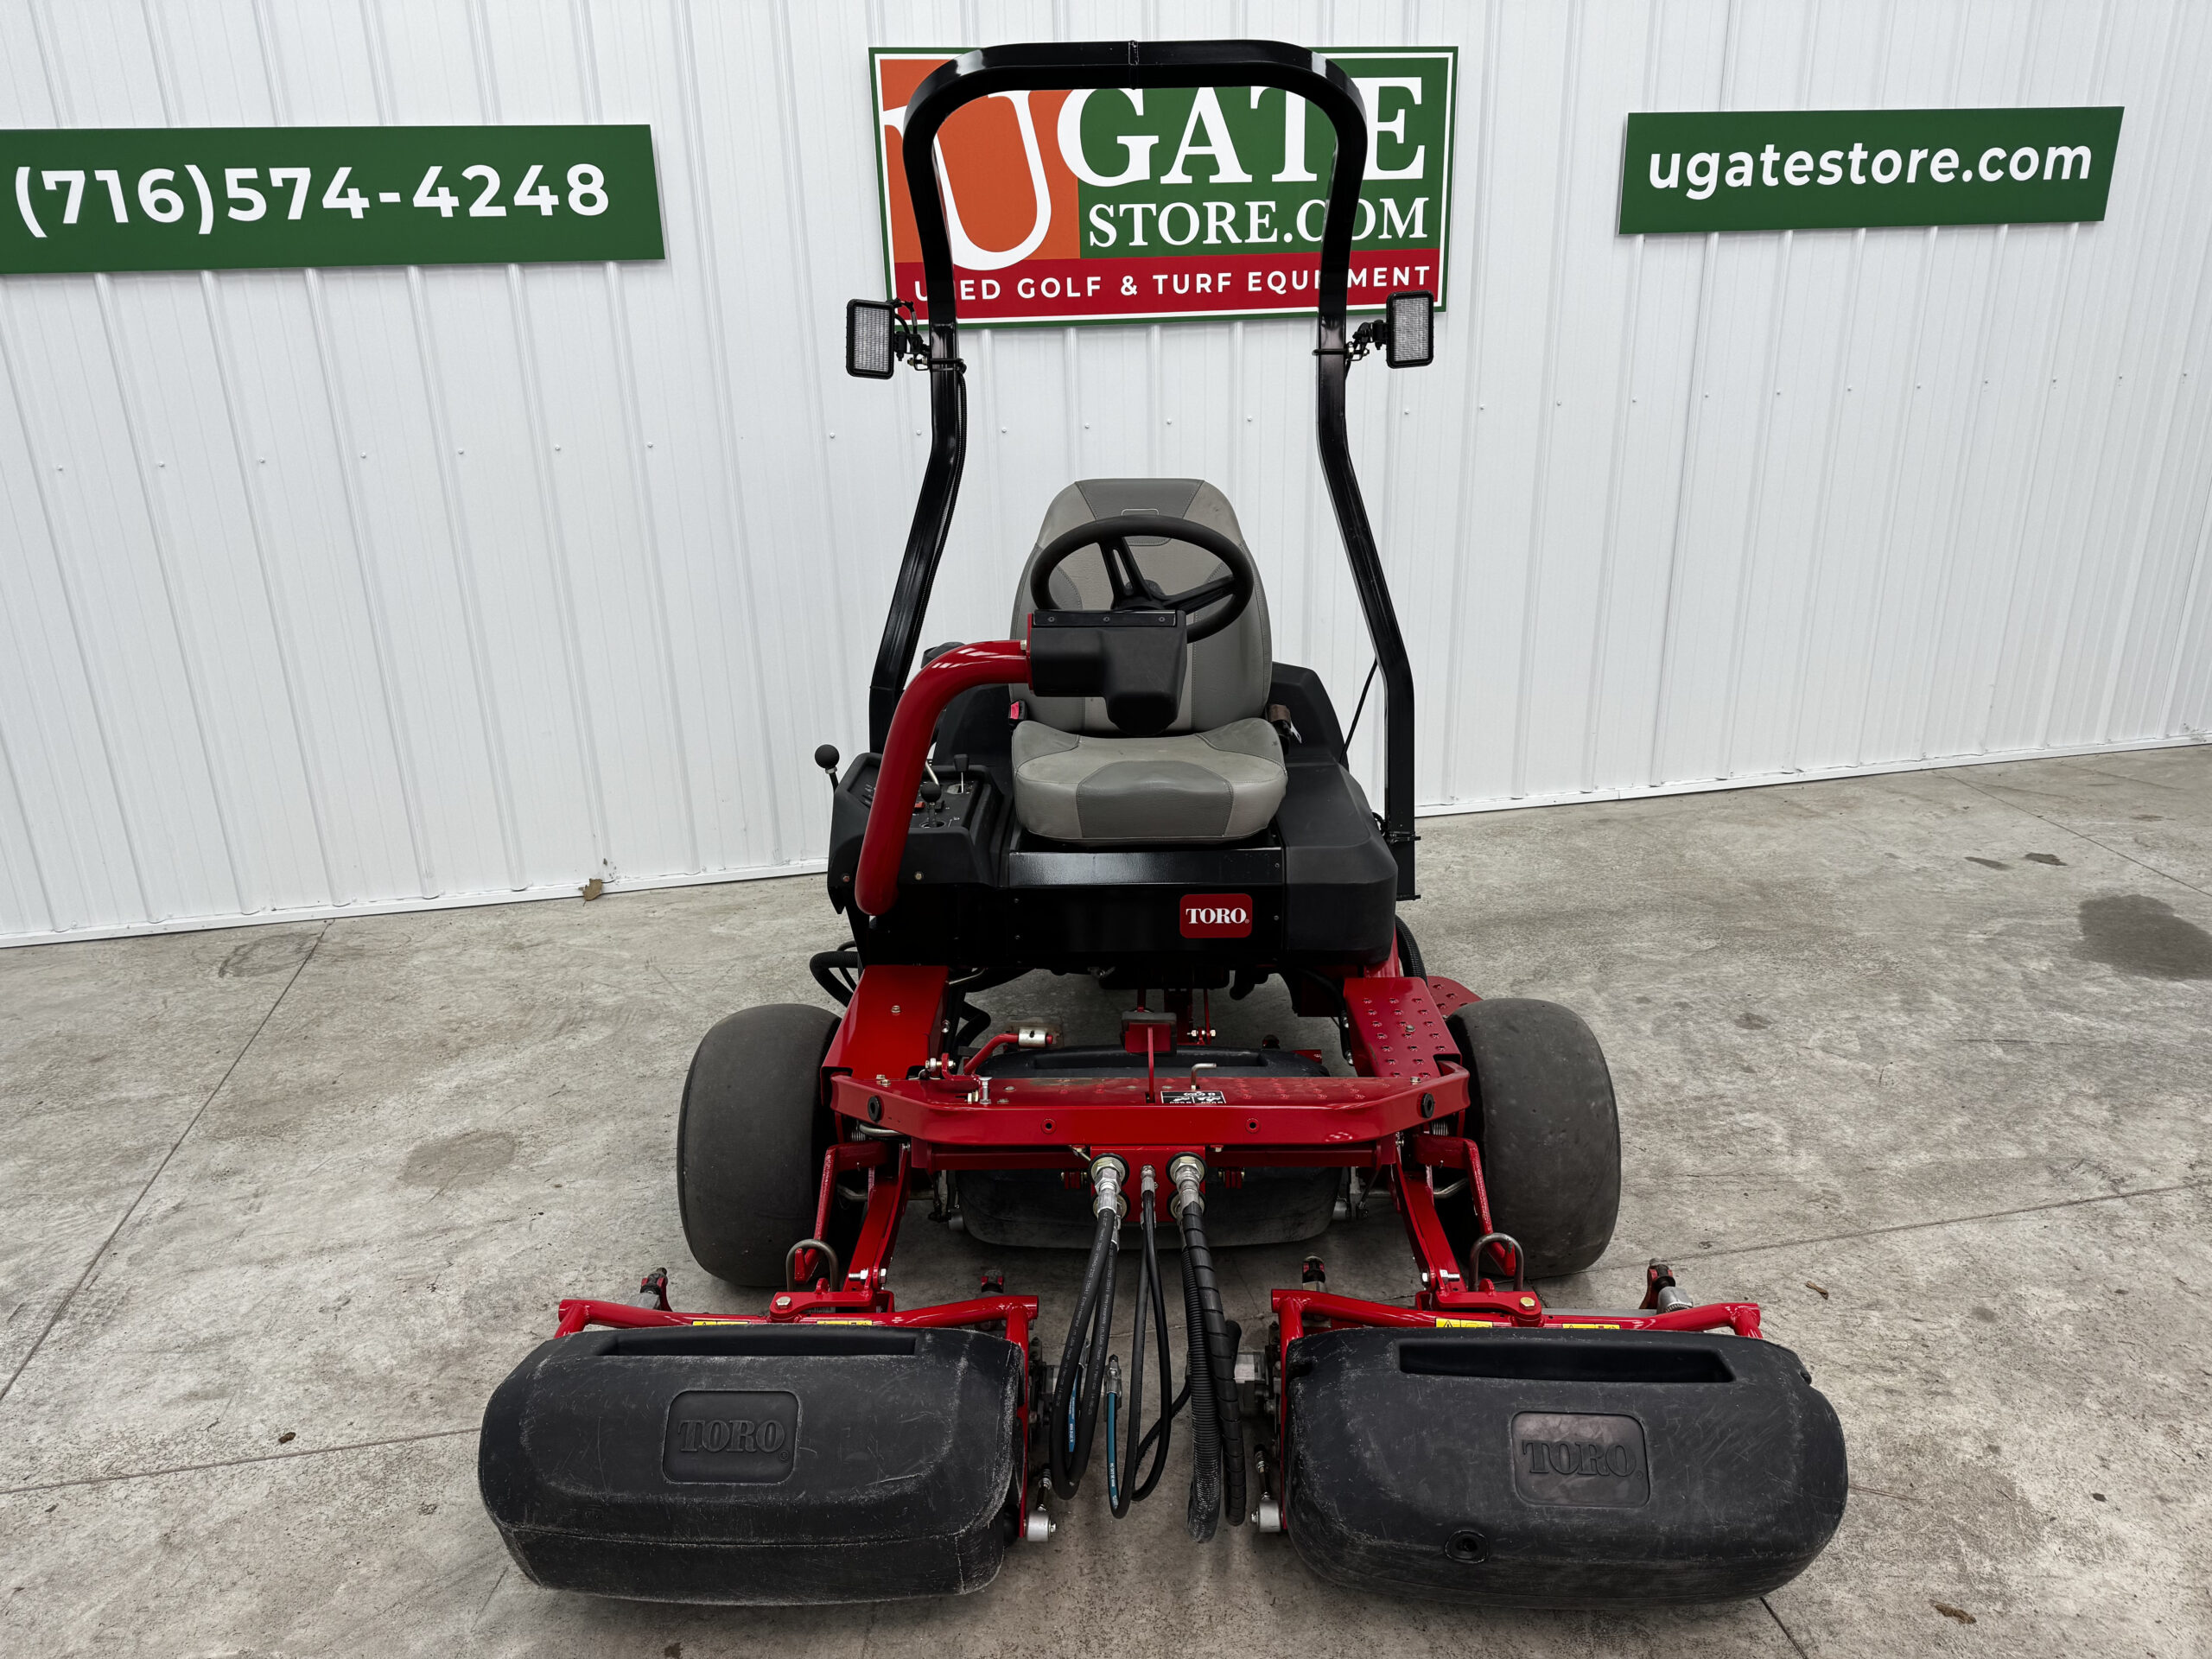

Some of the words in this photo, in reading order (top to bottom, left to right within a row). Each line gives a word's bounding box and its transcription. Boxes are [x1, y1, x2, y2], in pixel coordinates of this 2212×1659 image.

[1648, 142, 2092, 200] ugatestore.com
[15, 162, 609, 238] (716)574-4248
[914, 278, 1001, 302] UED
[1017, 276, 1102, 299] GOLF
[1120, 275, 1138, 296] &
[1152, 272, 1232, 295] TURF
[1248, 265, 1430, 296] EQUIMENT
[1185, 907, 1247, 925] TORO
[677, 1419, 785, 1453] TORO
[1522, 1439, 1637, 1478] TORO
